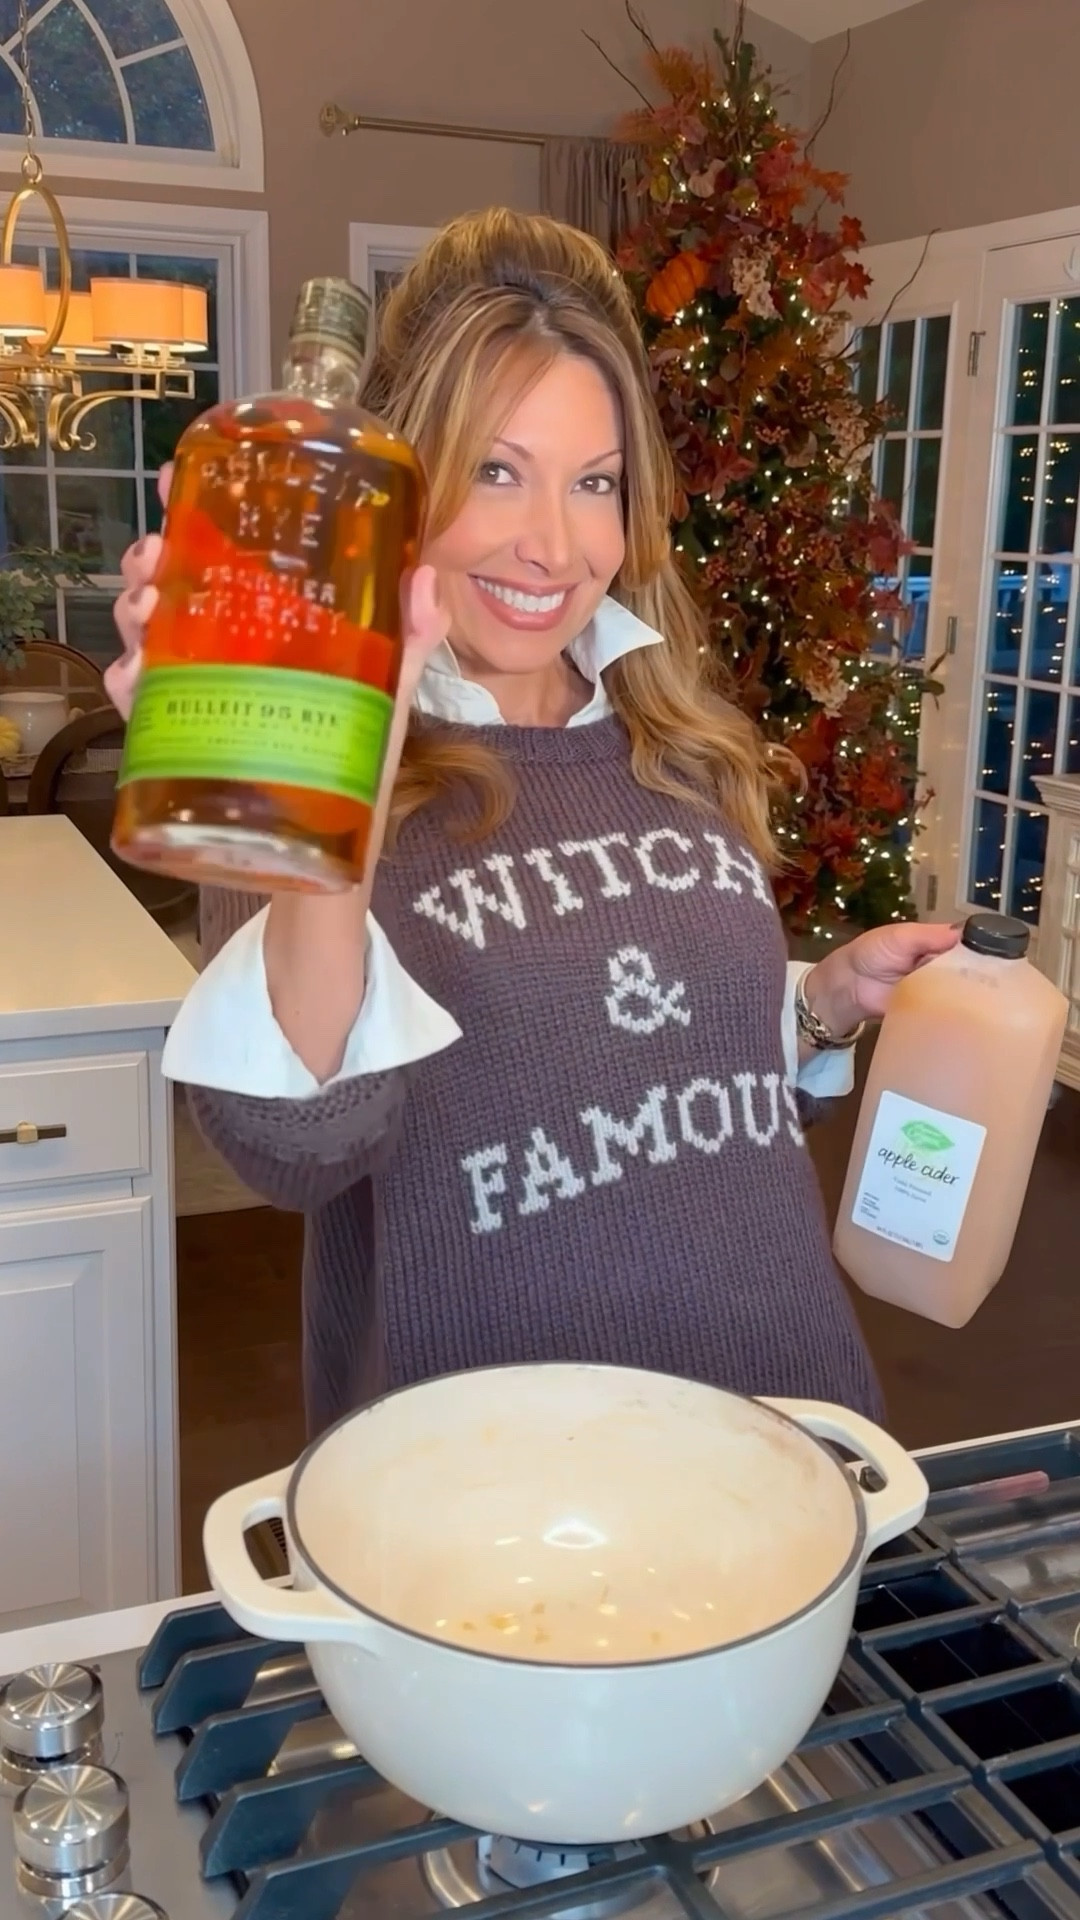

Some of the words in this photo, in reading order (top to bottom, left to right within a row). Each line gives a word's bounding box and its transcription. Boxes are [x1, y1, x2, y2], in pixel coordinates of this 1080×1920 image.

[166, 700, 254, 717] BULLEIT
[260, 704, 292, 720] 95
[302, 709, 340, 728] RYE
[413, 827, 774, 949] WITCH
[604, 945, 691, 1035] &
[877, 1147, 919, 1169] apple
[920, 1165, 960, 1185] cider
